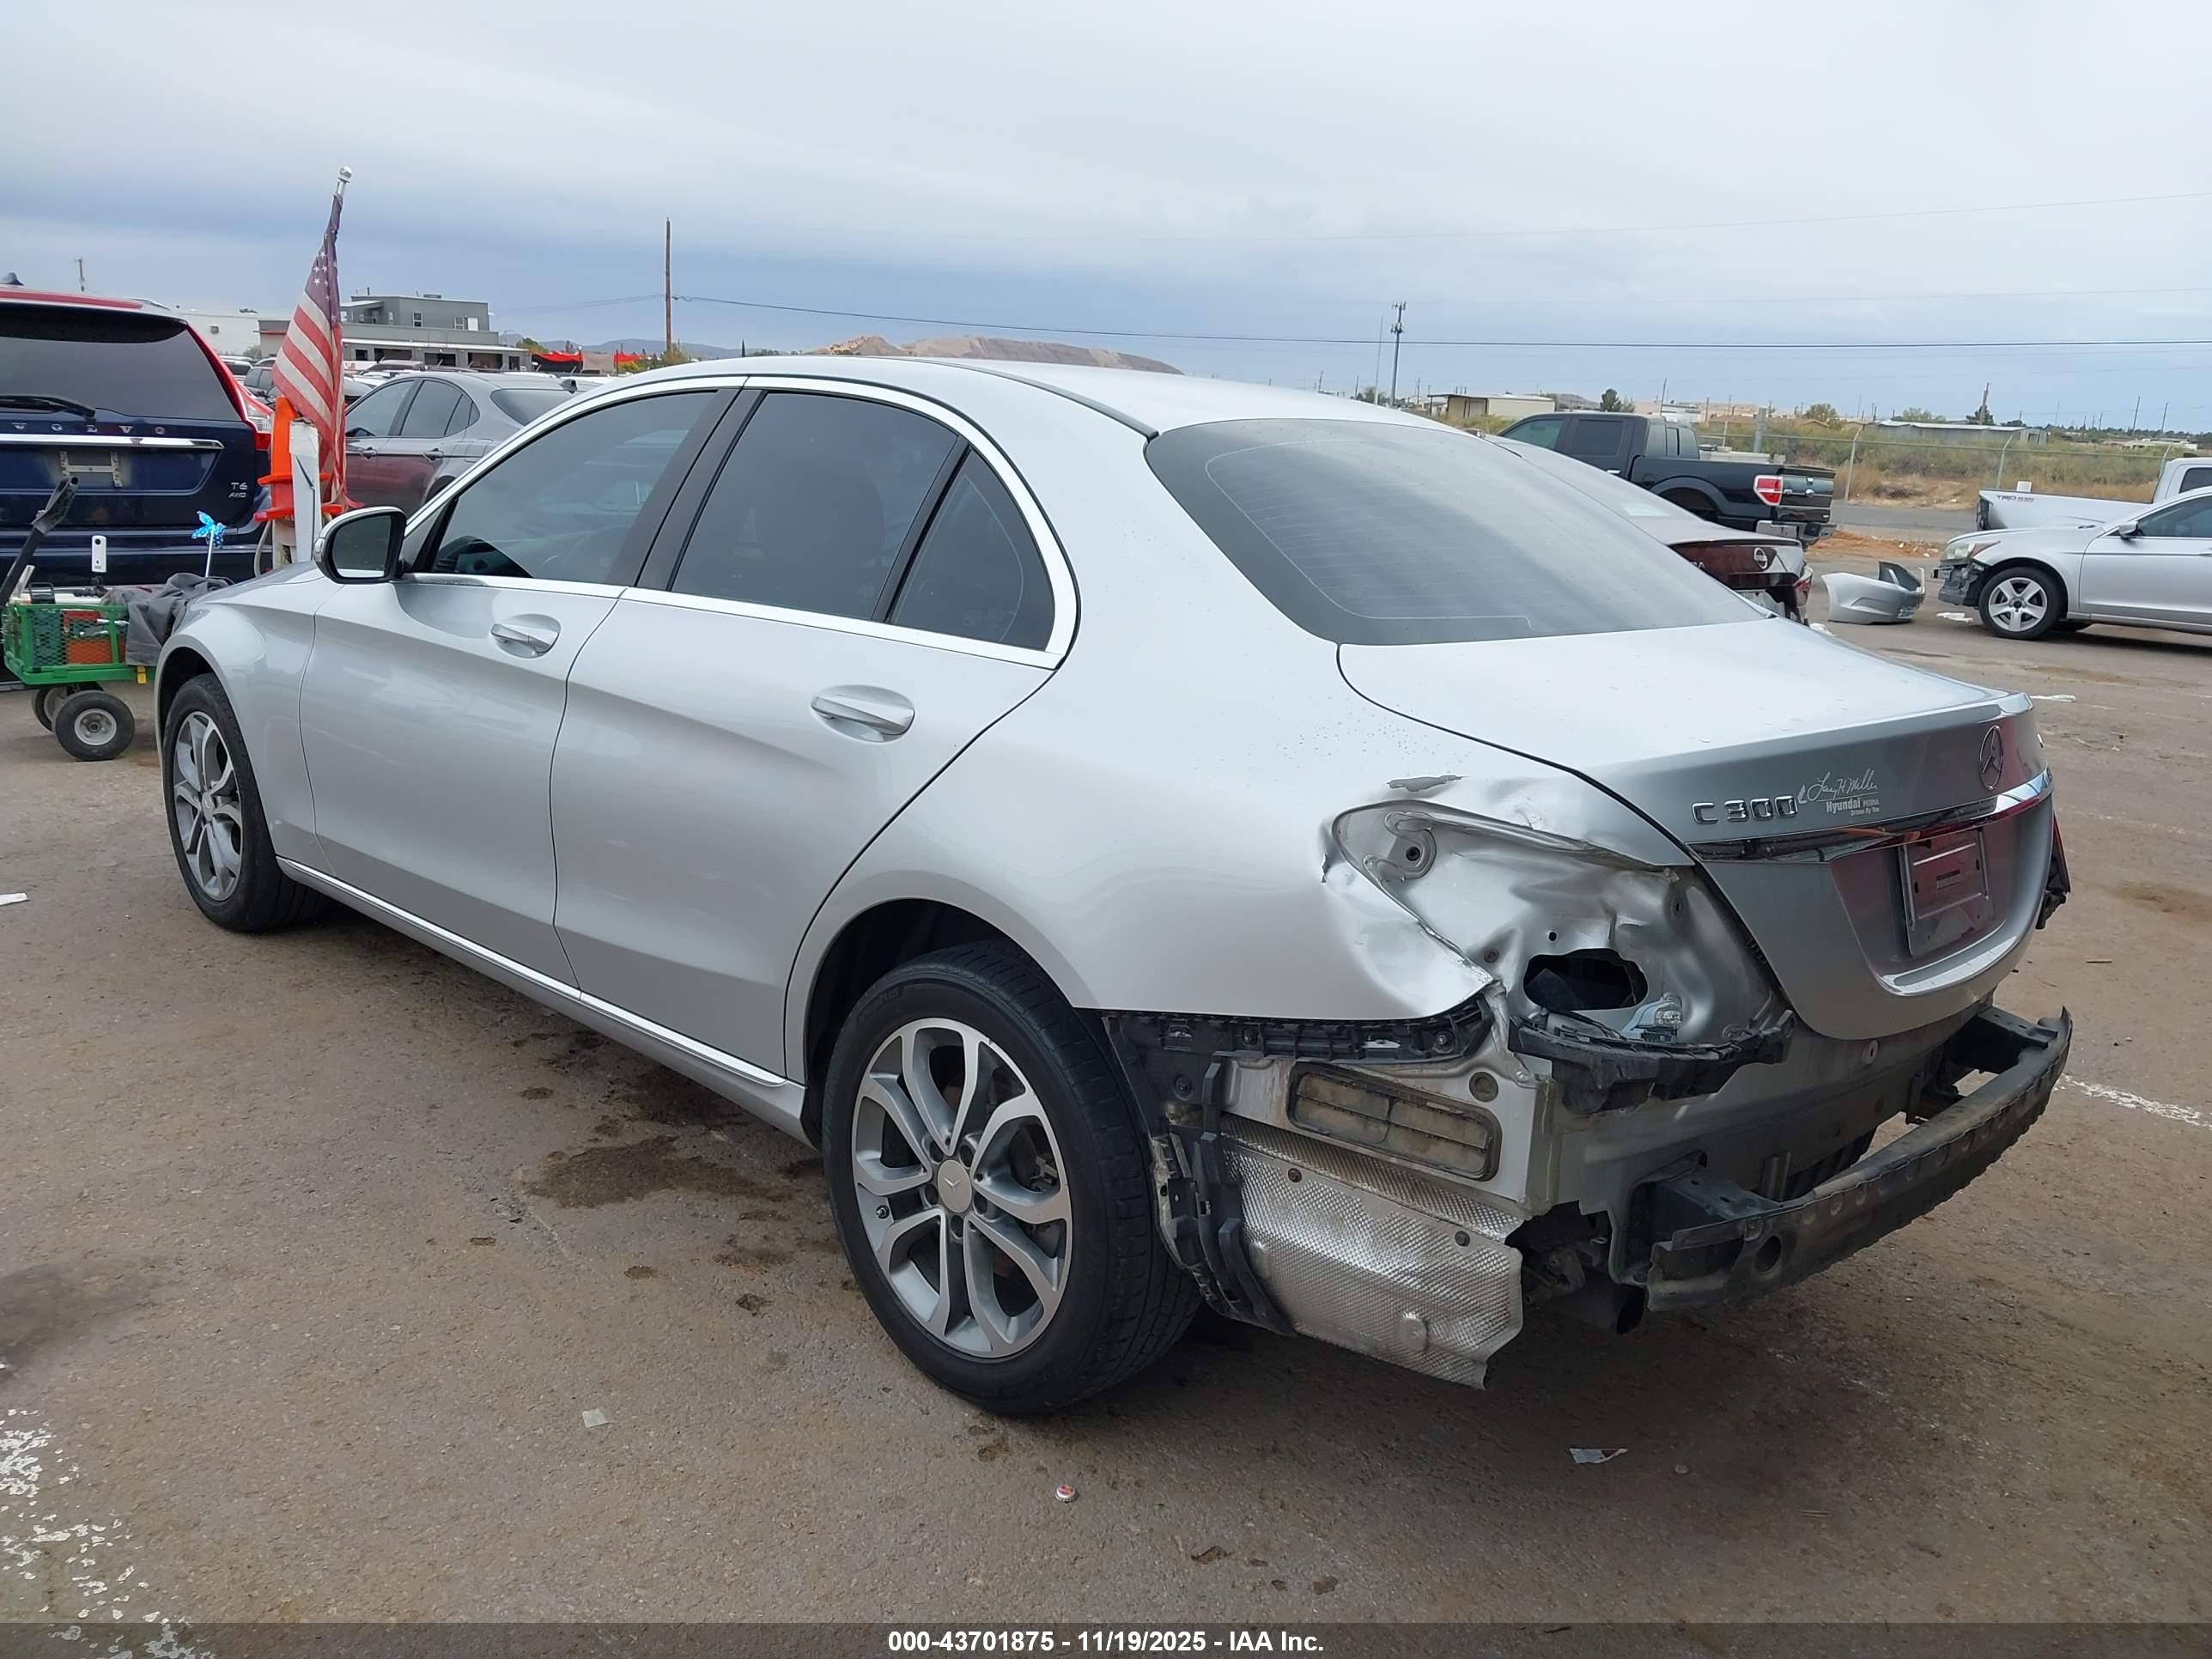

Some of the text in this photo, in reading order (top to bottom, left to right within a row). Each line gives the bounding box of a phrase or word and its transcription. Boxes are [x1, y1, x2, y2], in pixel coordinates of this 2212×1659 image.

[11, 422, 166, 435] VOLVO
[230, 482, 248, 490] T6
[1692, 795, 1799, 825] C 300
[1826, 797, 1862, 814] Hyundai
